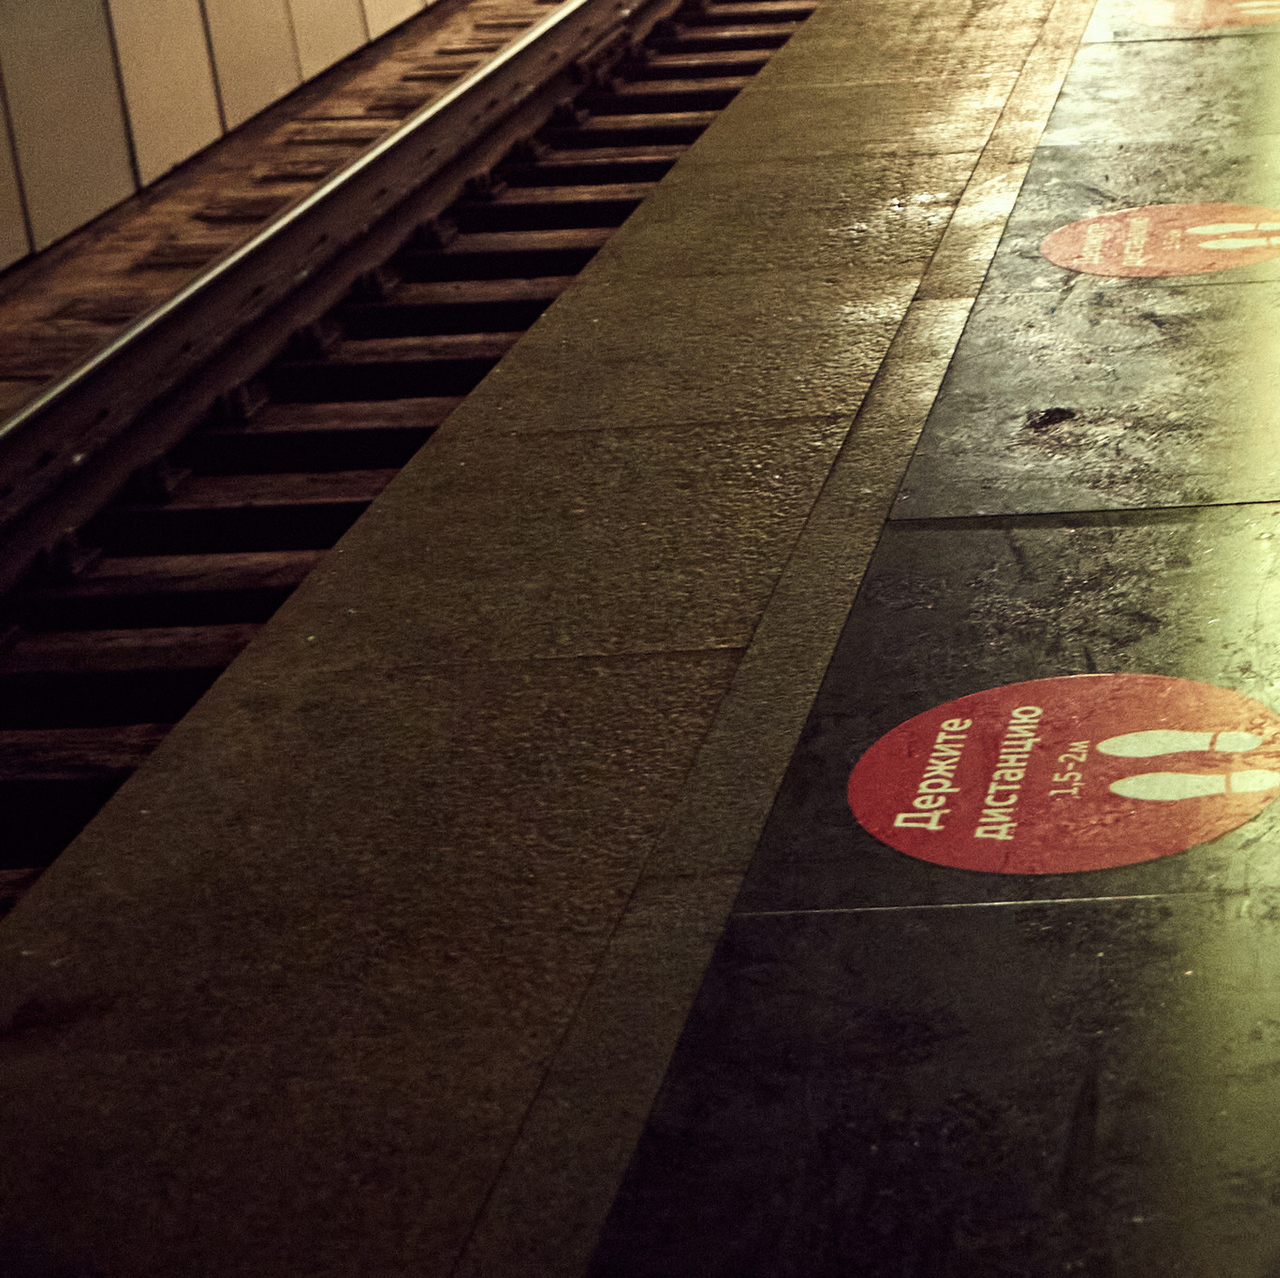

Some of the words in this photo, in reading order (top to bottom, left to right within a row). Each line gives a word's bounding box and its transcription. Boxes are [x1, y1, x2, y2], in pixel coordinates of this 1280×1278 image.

[894, 718, 972, 830] Держите
[974, 706, 1043, 840] дистанцию
[1049, 740, 1091, 798] 1,5-2м
